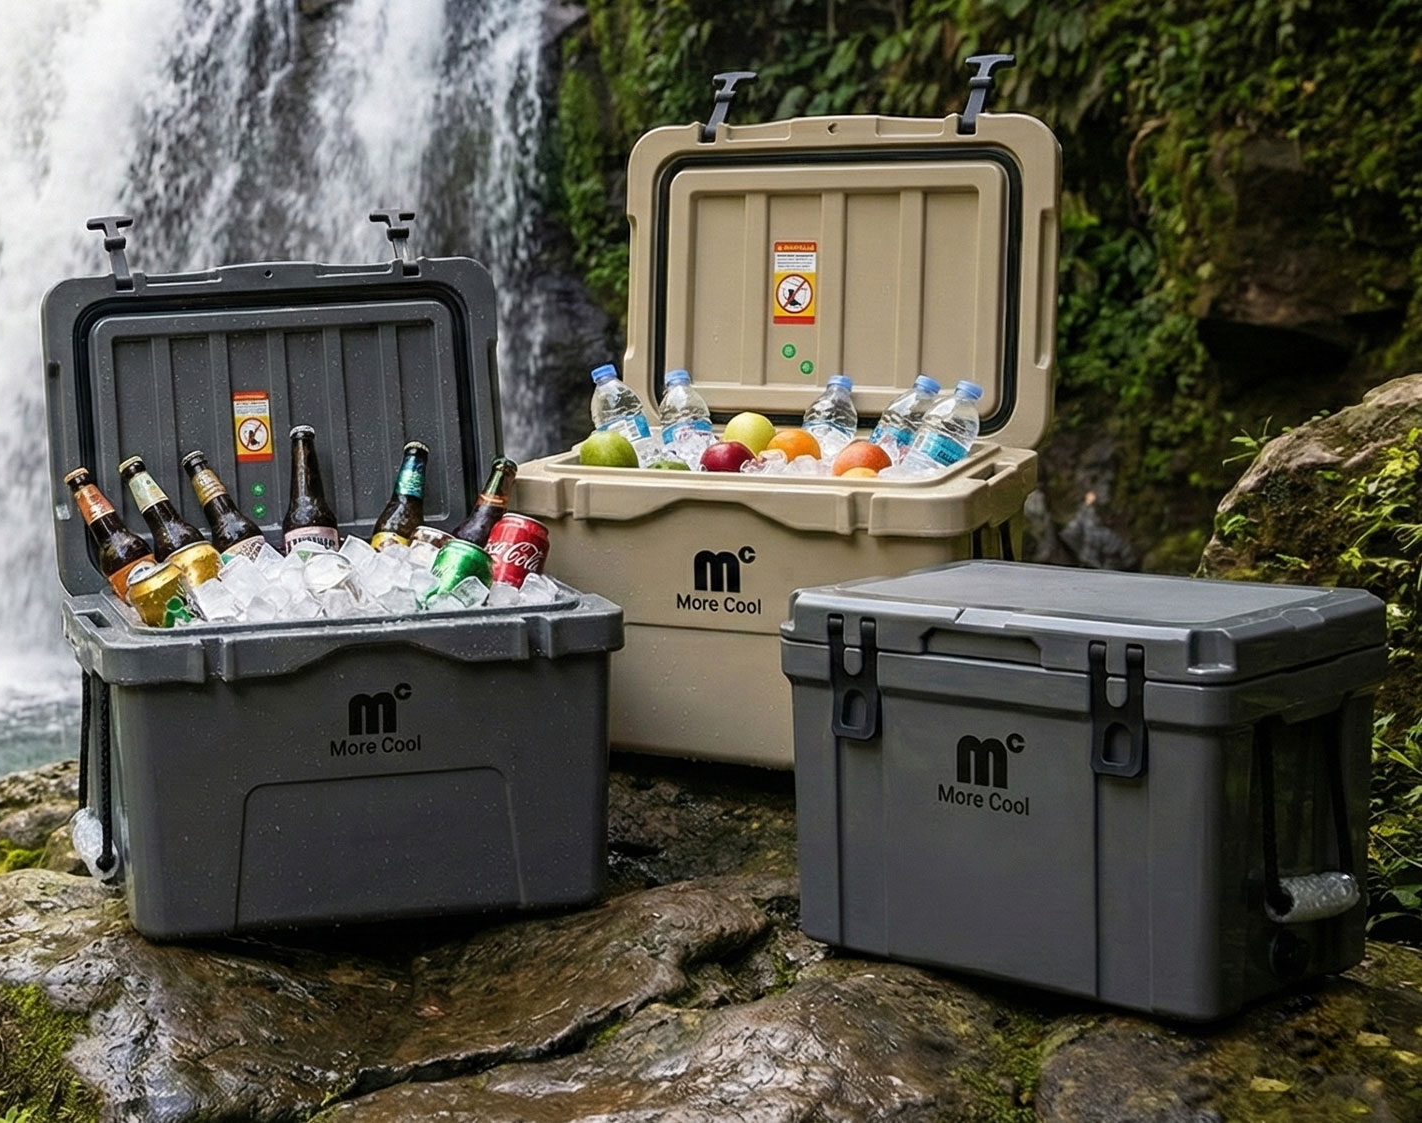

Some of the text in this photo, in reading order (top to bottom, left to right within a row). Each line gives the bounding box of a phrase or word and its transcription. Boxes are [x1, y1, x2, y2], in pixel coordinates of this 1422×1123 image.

[677, 593, 761, 615] More Cool
[330, 734, 421, 757] More Cool
[938, 784, 1030, 816] More Cool
